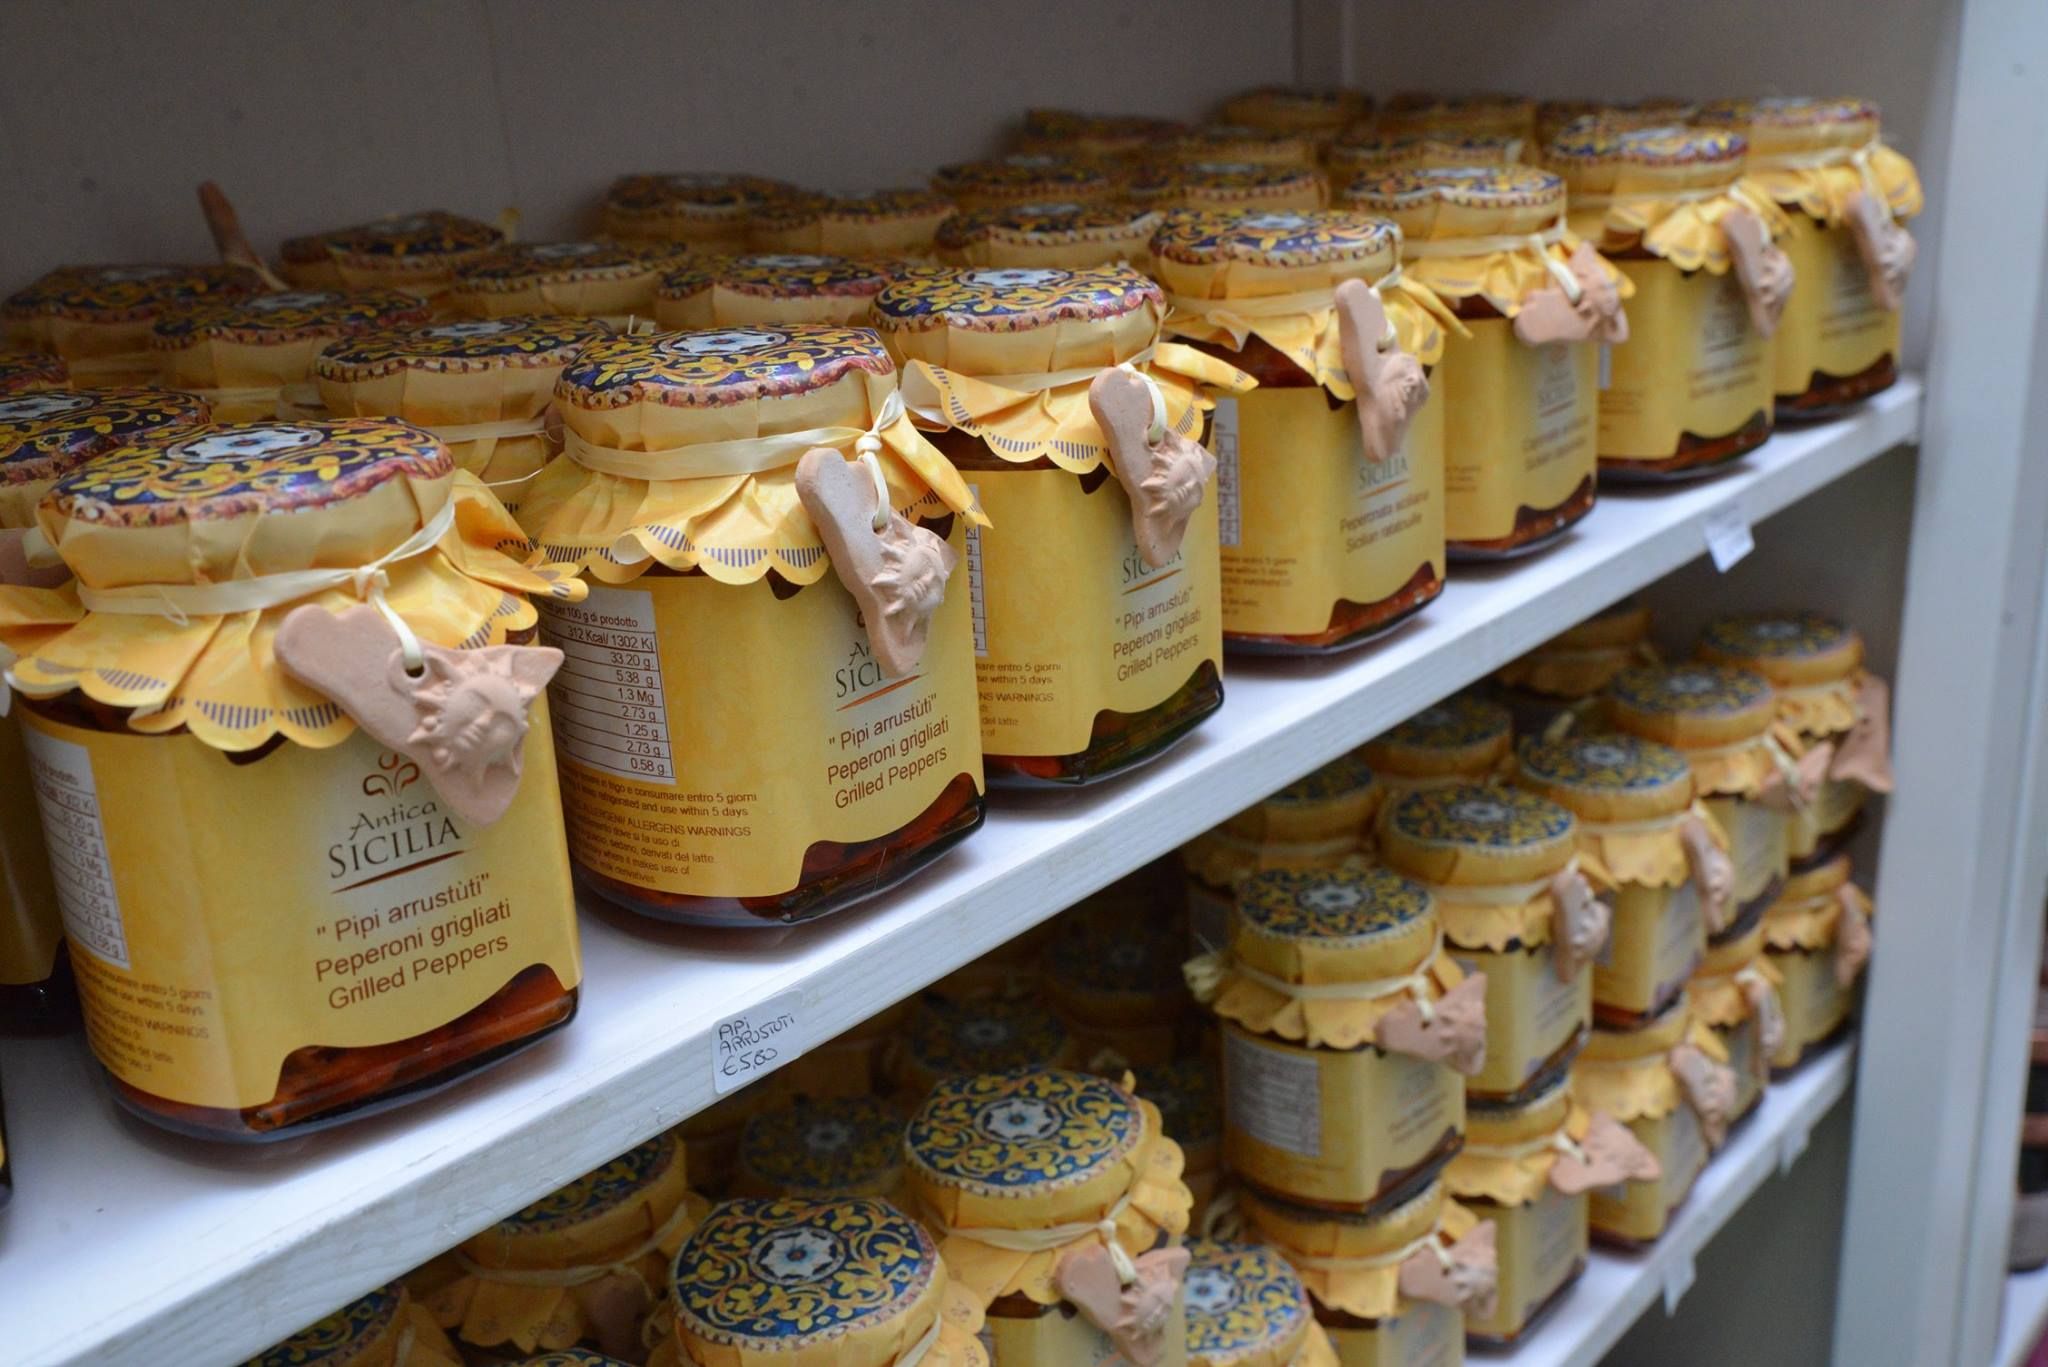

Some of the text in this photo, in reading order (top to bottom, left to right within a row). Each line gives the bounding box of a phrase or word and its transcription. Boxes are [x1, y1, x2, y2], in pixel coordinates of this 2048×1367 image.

[611, 634, 639, 649] 1302
[827, 715, 950, 785] Peperoni grigliati
[840, 722, 870, 750] Pipi
[630, 757, 655, 772] 0.58
[835, 747, 947, 809] Grilled Peppers
[711, 807, 720, 817] 5
[721, 807, 750, 818] days
[716, 793, 724, 803] 5
[349, 801, 437, 841] Antica
[687, 825, 752, 837] WARNINGS
[328, 816, 461, 879] SICILIA
[315, 898, 511, 982] Peperoni grigliati
[335, 908, 380, 942] Pipi
[328, 935, 509, 1010] Grilled Peppers
